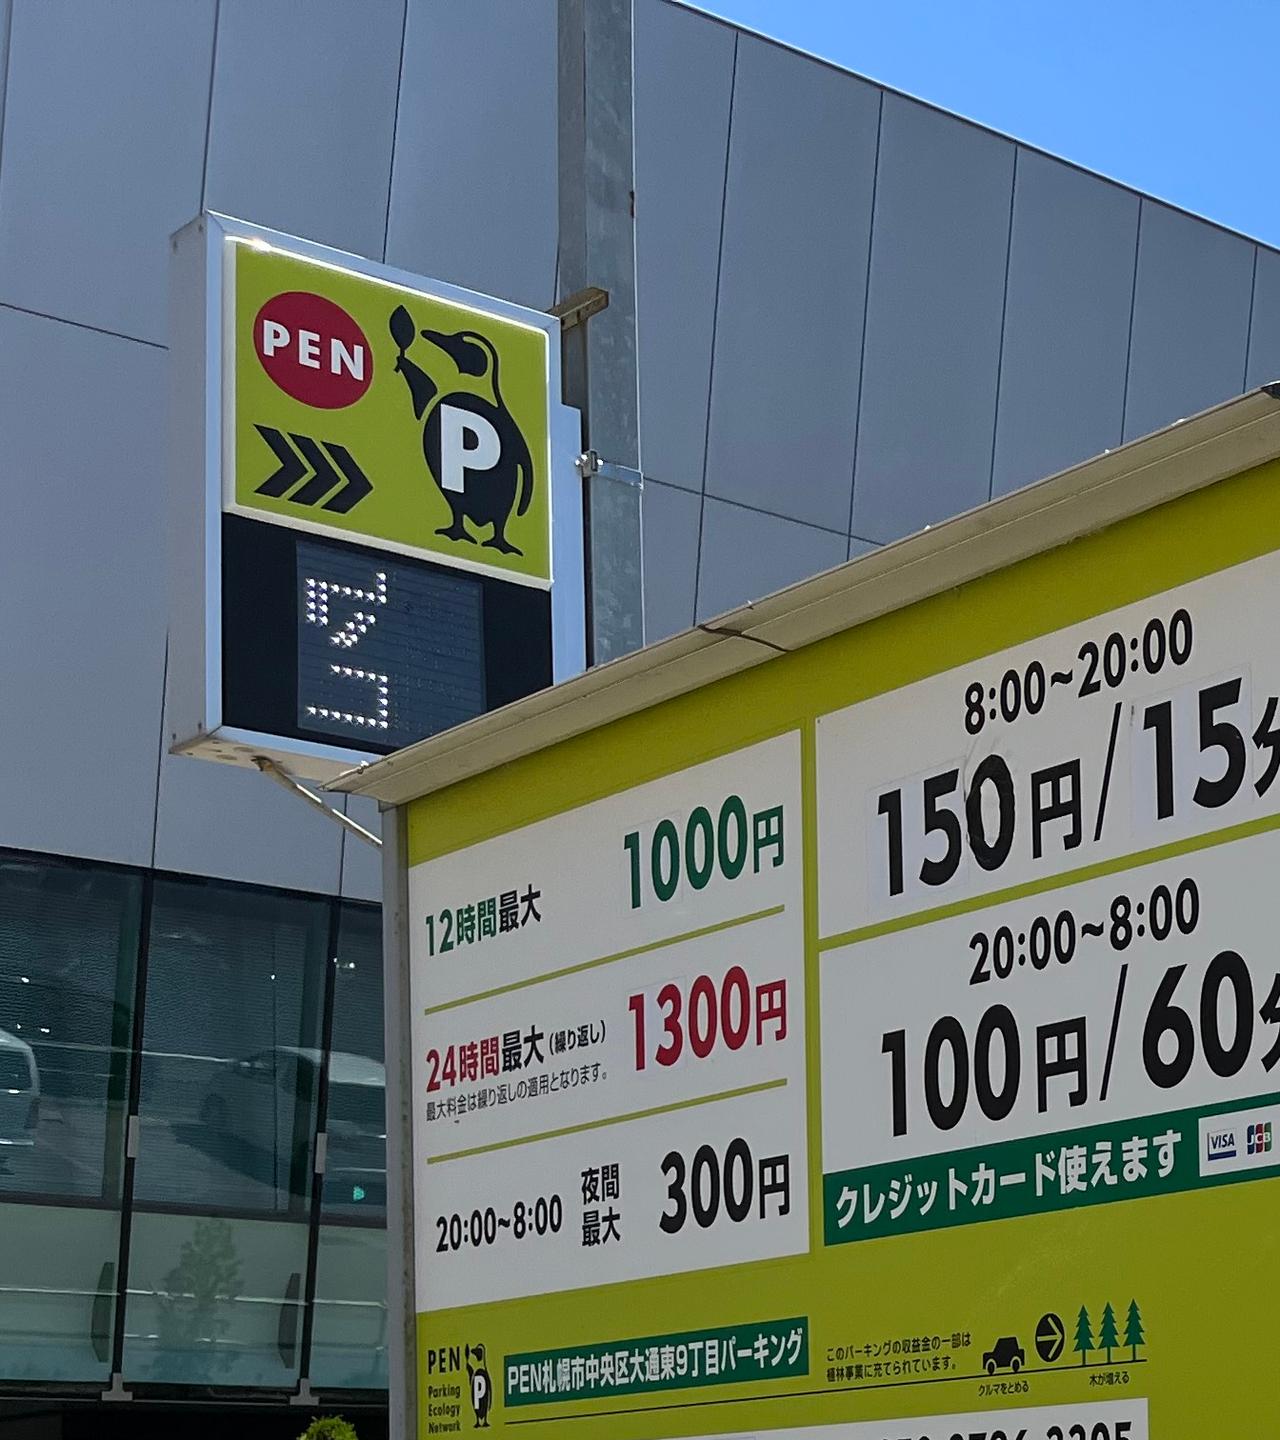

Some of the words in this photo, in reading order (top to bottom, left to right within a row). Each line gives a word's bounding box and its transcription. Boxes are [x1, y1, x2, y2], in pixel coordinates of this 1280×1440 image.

[262, 319, 365, 381] PEN
[440, 403, 501, 494] P
[425, 884, 542, 956] 12時間最大
[623, 795, 785, 909] 1000円
[627, 965, 788, 1071] 1300円
[426, 1063, 607, 1122] 最大料金は繰り返しの適用となります。
[1211, 1132, 1235, 1150] VISA
[1247, 1131, 1271, 1146] JCB
[580, 1162, 620, 1203] 夜間
[659, 1137, 791, 1235] 300円
[835, 1128, 1182, 1229] クレジットカード使えます
[581, 1206, 621, 1249] 最大
[428, 1346, 460, 1374] PEN
[507, 1328, 802, 1395] PEN札幌市中央区大通東9丁目パーキング
[1089, 1371, 1130, 1387] 木が増える
[428, 1384, 460, 1399] Parking
[474, 1375, 486, 1410] P
[978, 1380, 1029, 1397] クルマをとめる
[428, 1403, 460, 1417] Ecology
[428, 1420, 461, 1434] Network
